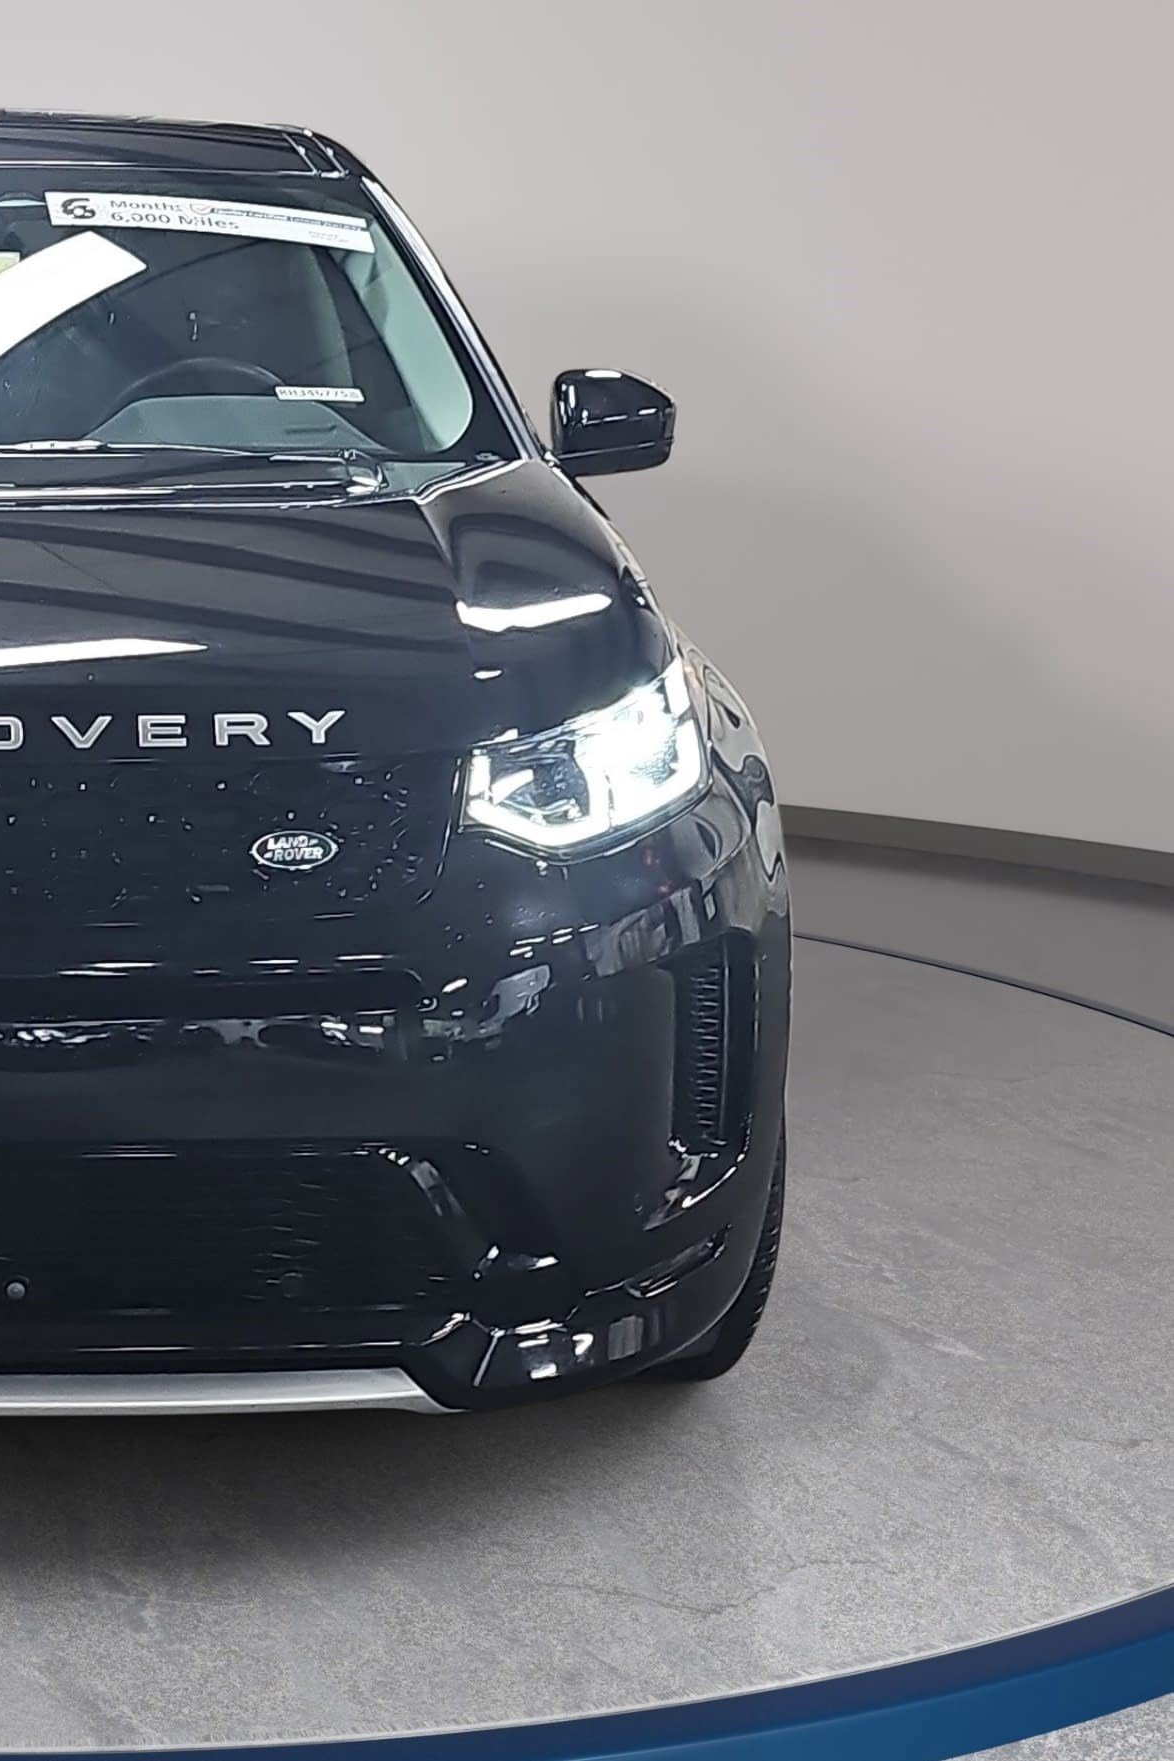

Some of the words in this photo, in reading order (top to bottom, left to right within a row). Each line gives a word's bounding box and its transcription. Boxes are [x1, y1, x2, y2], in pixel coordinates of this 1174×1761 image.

[110, 200, 183, 213] Months
[111, 212, 171, 224] 6,000
[178, 215, 240, 229] Miles
[266, 835, 309, 849] LAND
[272, 846, 324, 862] ROVER
